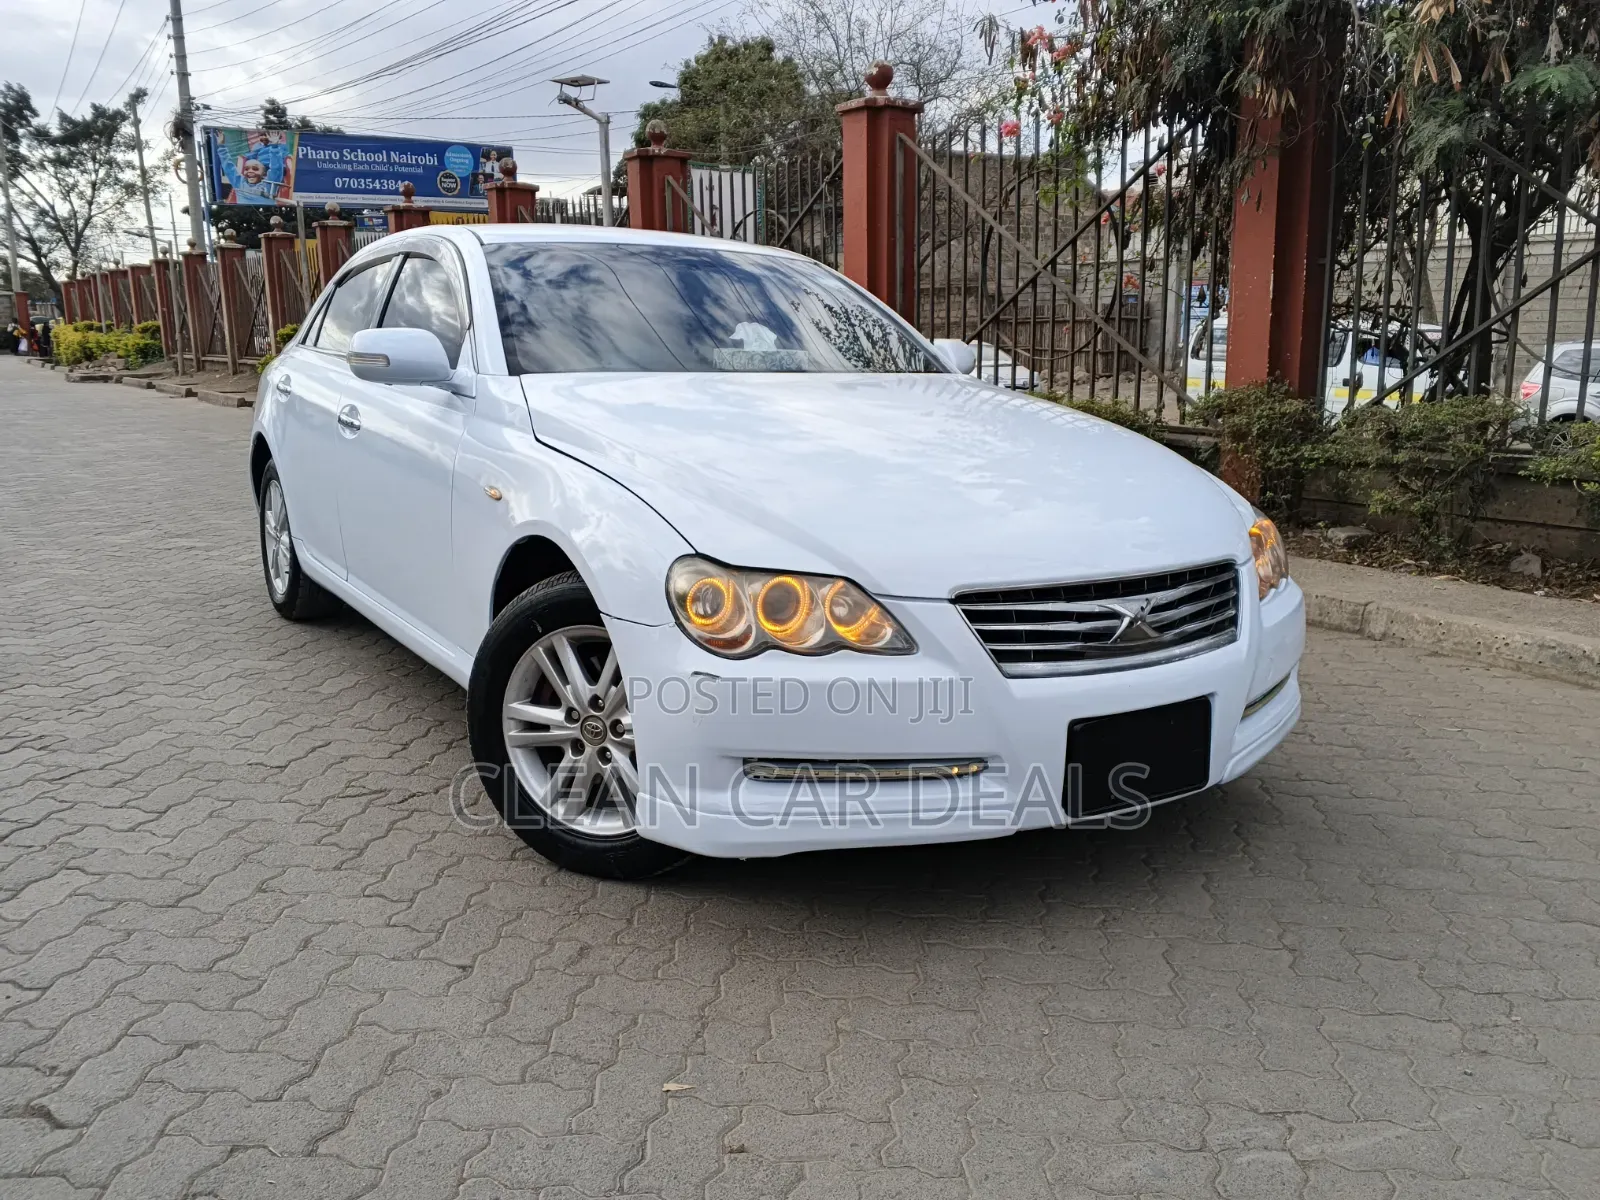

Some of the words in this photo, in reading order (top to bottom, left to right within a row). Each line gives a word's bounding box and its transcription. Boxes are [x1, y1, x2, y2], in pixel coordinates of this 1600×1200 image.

[298, 146, 340, 160] Pharo
[343, 148, 387, 162] School
[390, 151, 438, 165] Nairobi
[317, 161, 352, 171] Unlocking
[353, 163, 370, 171] Each
[371, 163, 393, 171] Child's
[394, 165, 423, 173] Potential
[335, 177, 402, 190] 070354384
